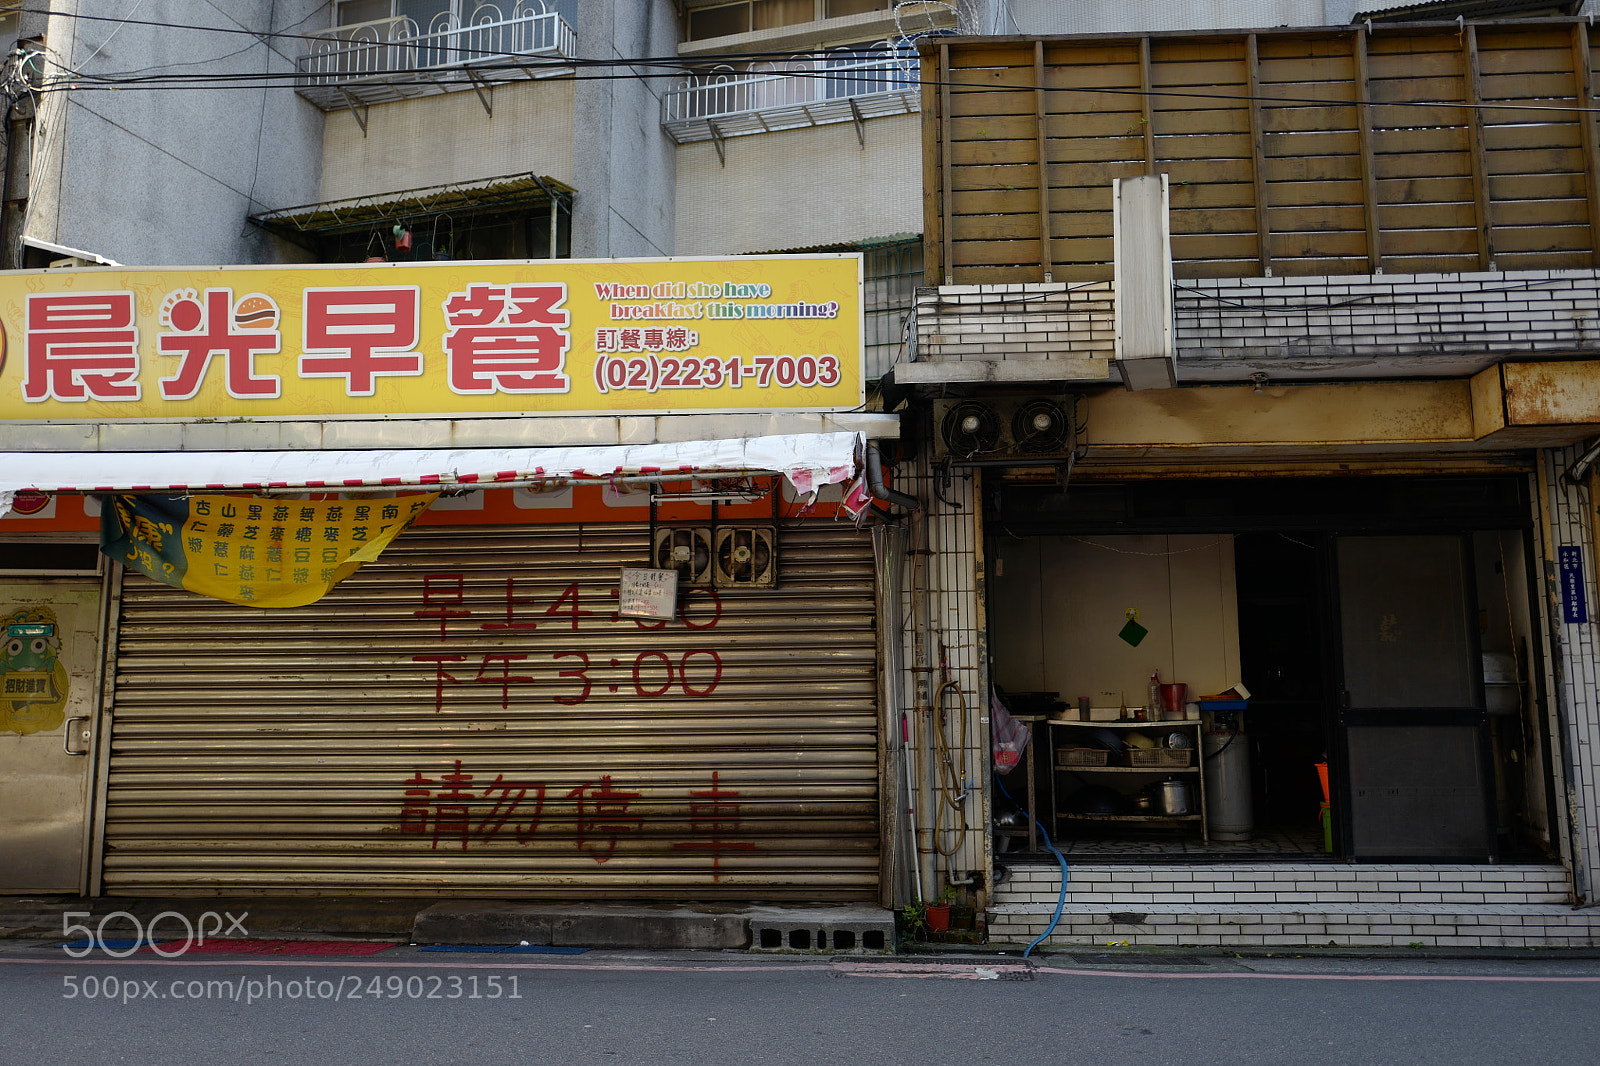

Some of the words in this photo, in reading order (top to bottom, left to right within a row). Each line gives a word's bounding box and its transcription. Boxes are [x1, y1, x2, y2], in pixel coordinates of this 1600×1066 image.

[594, 281, 649, 300] When
[652, 281, 685, 299] did
[687, 281, 721, 299] she
[724, 281, 771, 299] have
[610, 301, 703, 321] breakfast
[707, 301, 743, 320] this
[746, 301, 840, 320] morning?
[21, 282, 571, 403] 晨光早餐
[596, 327, 699, 351] 訂餐專線:
[594, 354, 840, 393] (02)2231-7003
[4, 678, 46, 694] 招財進寶
[400, 759, 756, 882] 請勿停車
